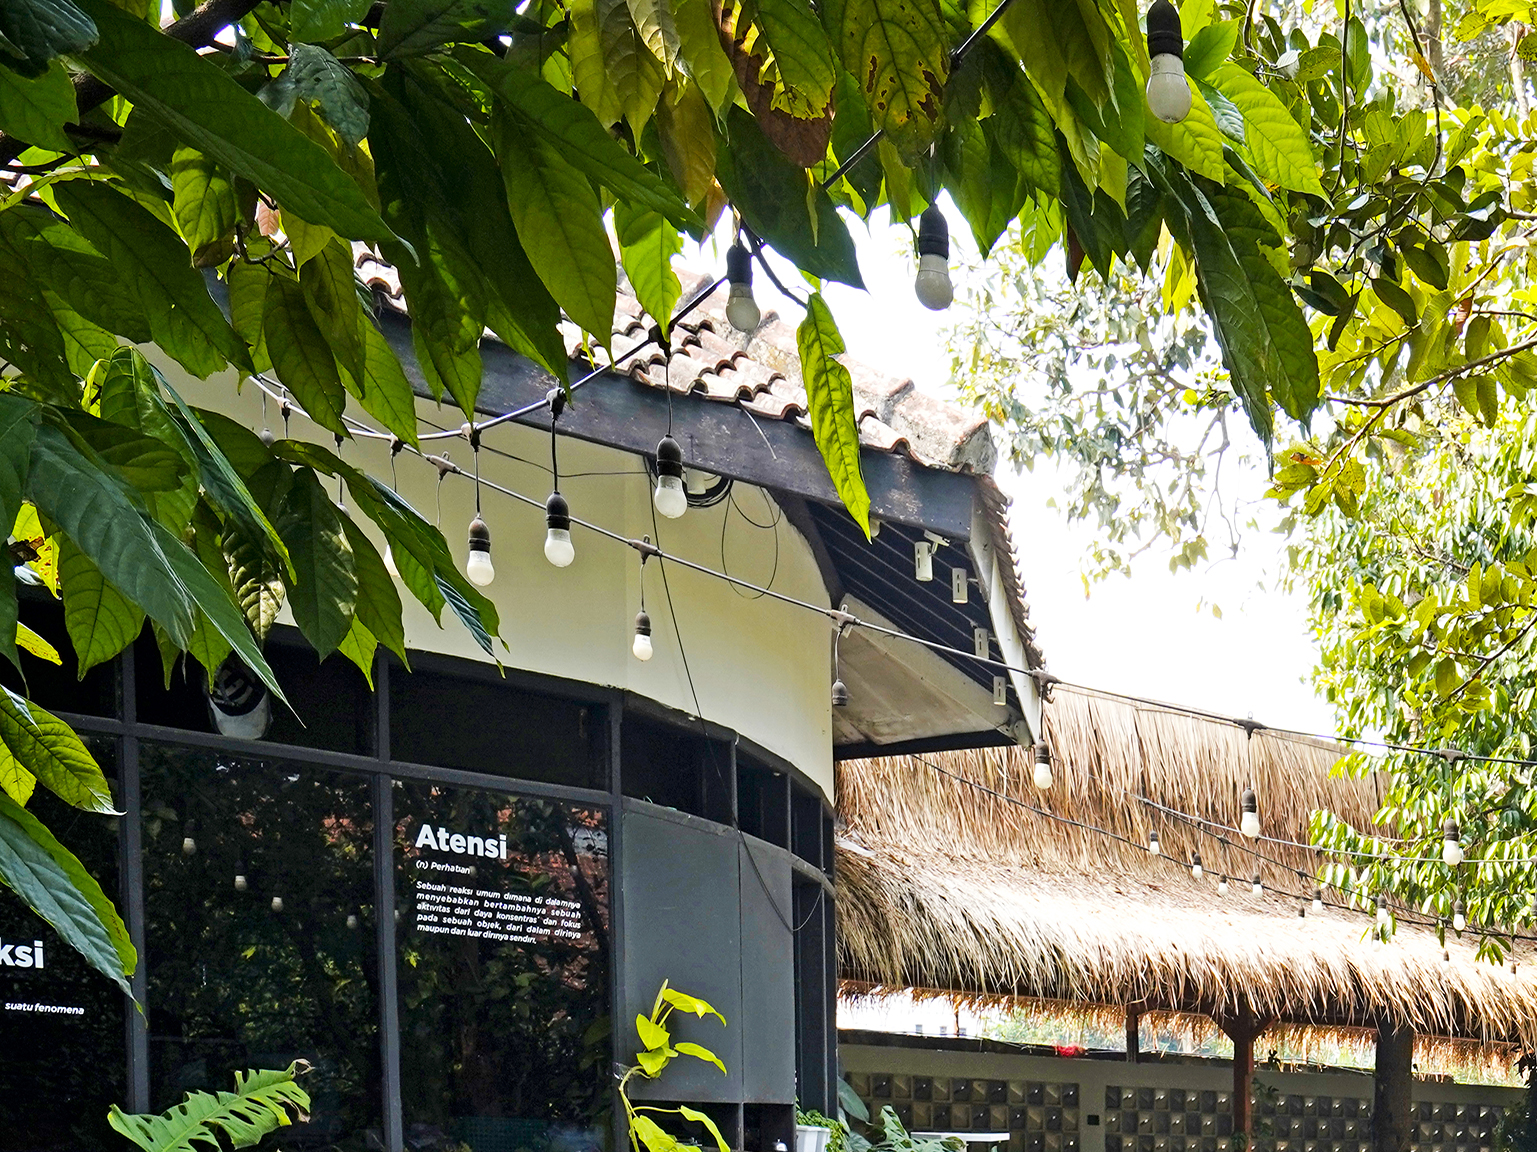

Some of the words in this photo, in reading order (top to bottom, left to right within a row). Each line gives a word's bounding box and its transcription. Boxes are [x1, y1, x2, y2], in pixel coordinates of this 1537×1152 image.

[415, 824, 507, 859] Atensi
[415, 860, 429, 870] (n)
[430, 862, 470, 875] Perhatian
[416, 881, 446, 892] Sebuah
[449, 887, 473, 895] reaksi
[476, 890, 501, 899] umum
[504, 893, 532, 902] dimana
[546, 898, 581, 909] dalamnya
[416, 893, 479, 906] menyebabkan
[484, 900, 546, 915] bertambahnya
[551, 909, 581, 919] sebuah
[416, 902, 450, 913] aktivitas
[454, 907, 470, 915] dari
[474, 910, 493, 919] daya
[543, 918, 558, 926] dan
[561, 919, 581, 929] fokus
[416, 914, 439, 922] pada
[442, 917, 473, 926] sebuah
[476, 920, 502, 930] objek,
[506, 924, 522, 932] dari
[526, 926, 551, 935] dalam
[554, 929, 581, 939] dirinya
[417, 924, 450, 934] maupun
[450, 927, 466, 936] dari
[482, 931, 508, 940] dirinya
[5, 1002, 34, 1012] suatu
[34, 1003, 85, 1015] fenomena
